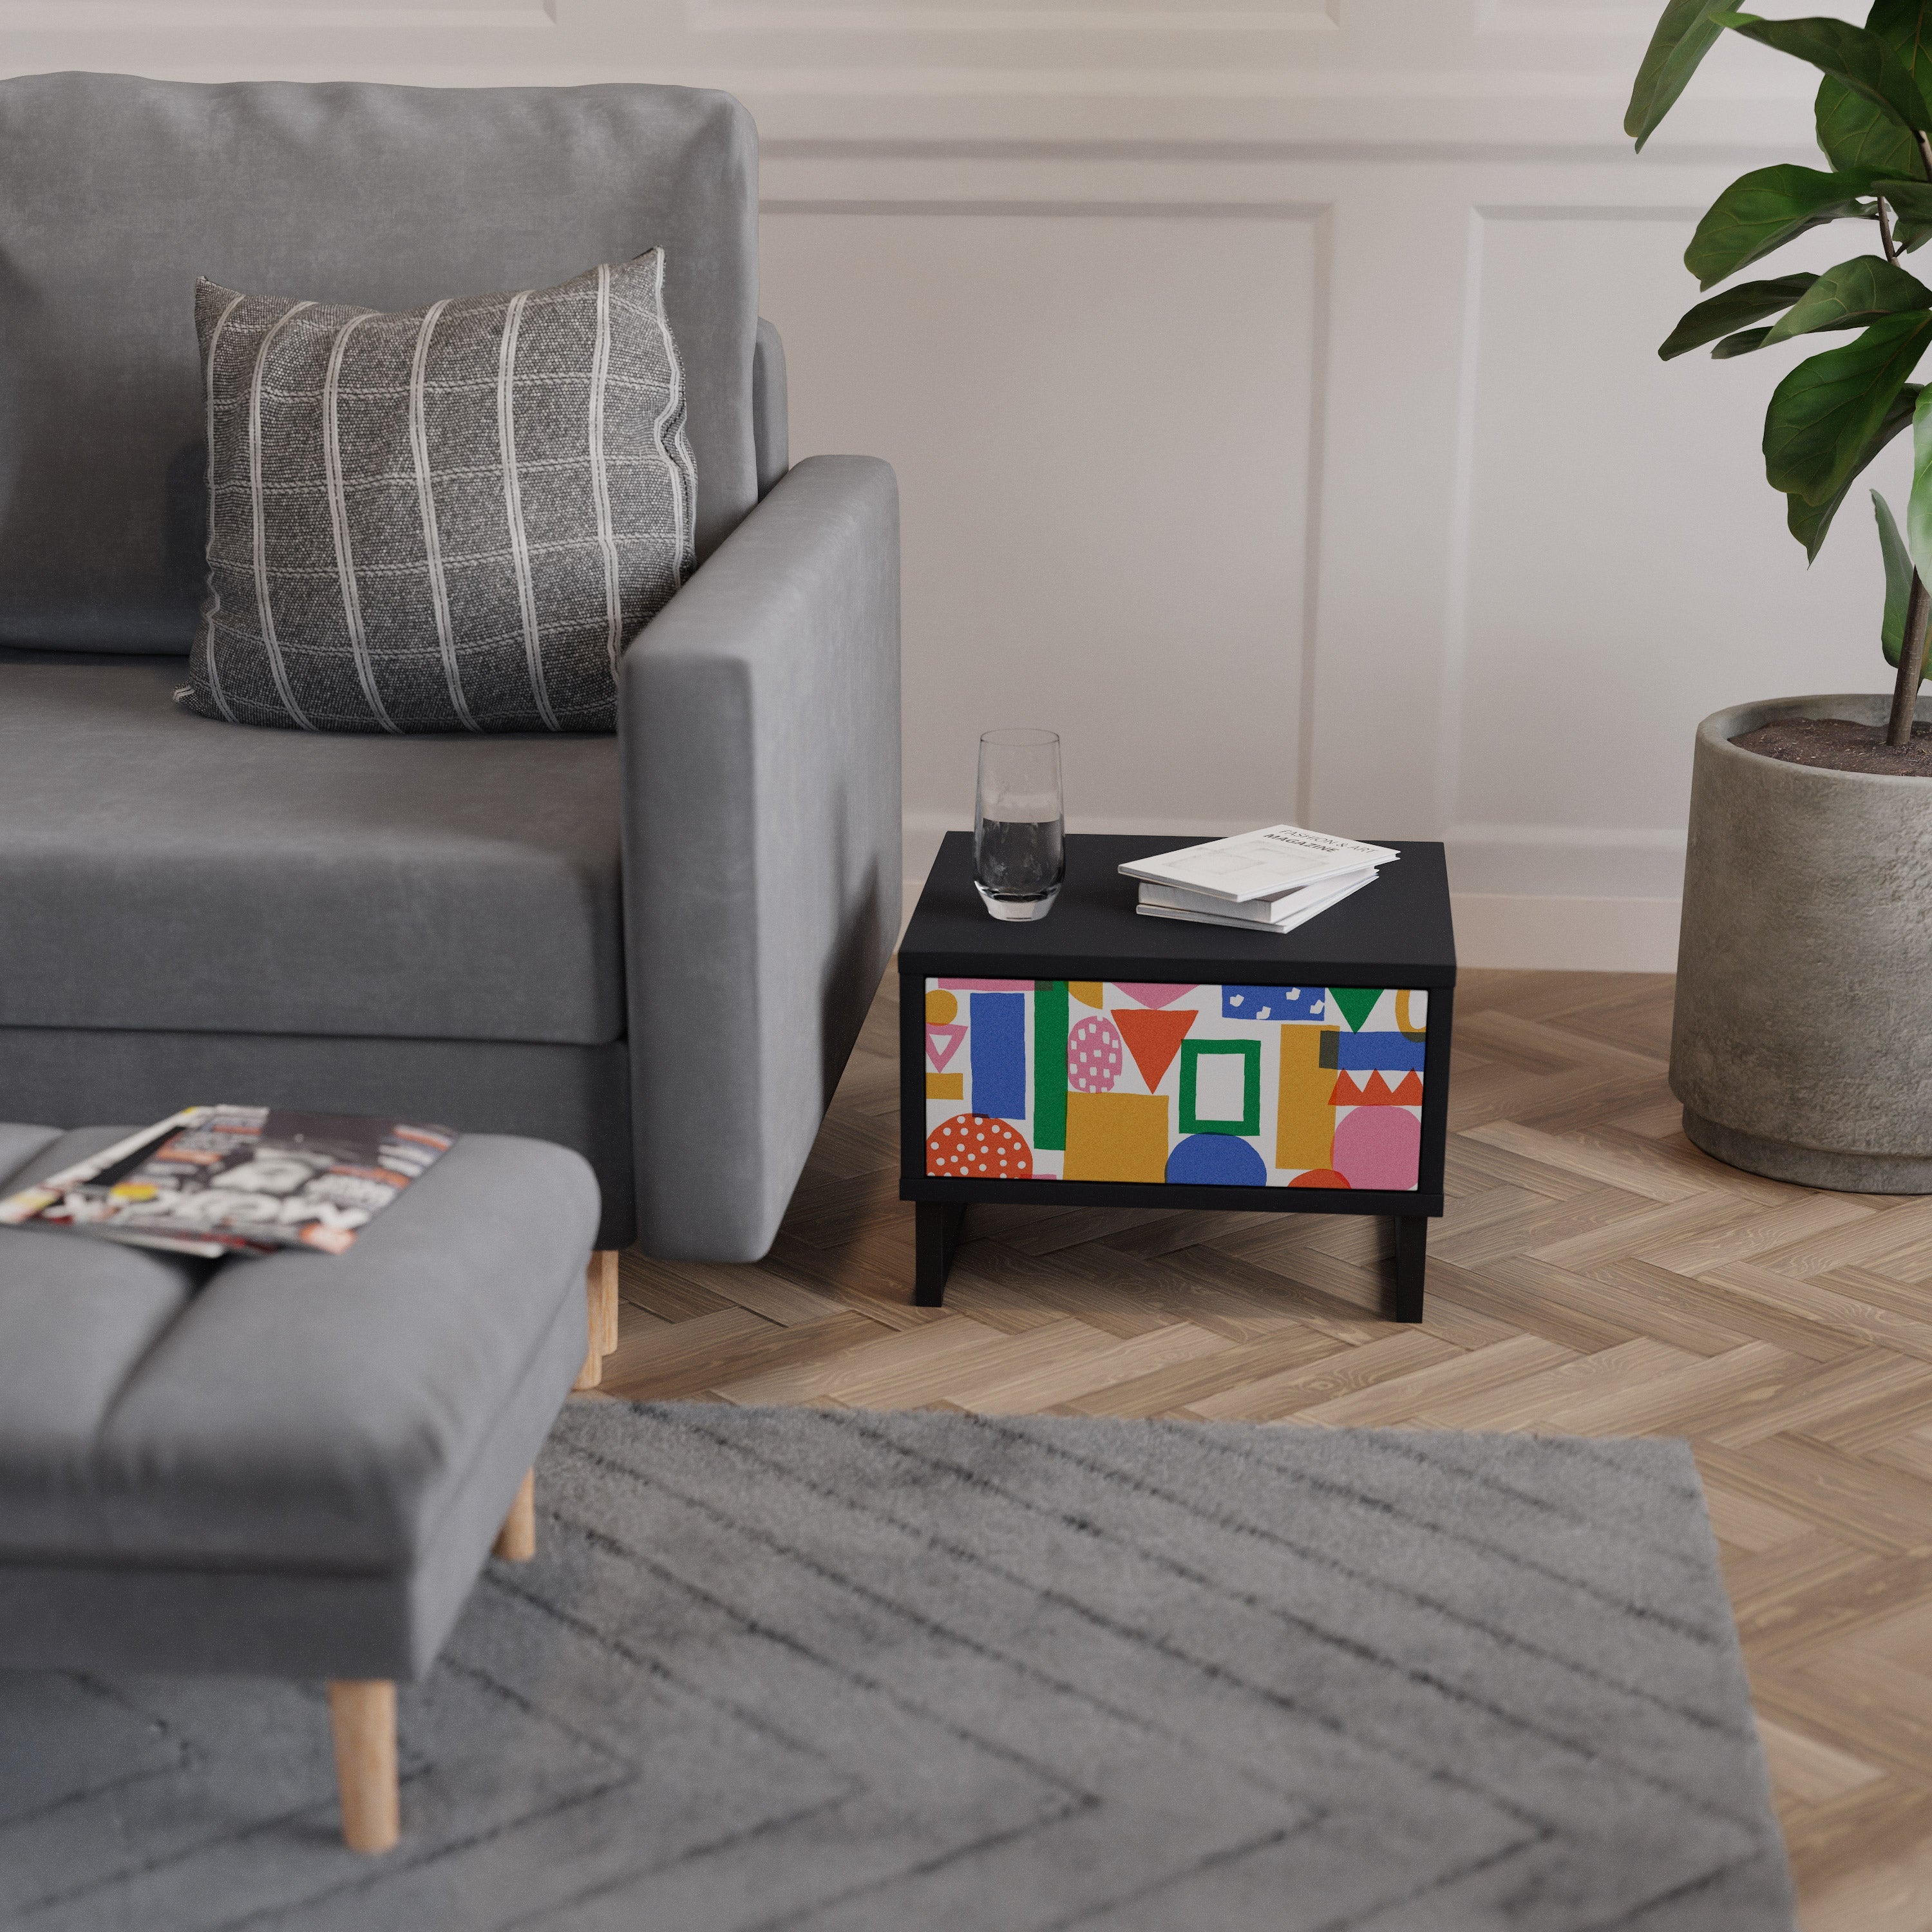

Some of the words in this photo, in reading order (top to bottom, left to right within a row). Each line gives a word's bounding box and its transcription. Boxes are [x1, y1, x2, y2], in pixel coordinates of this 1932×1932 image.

[1264, 833, 1340, 853] MAGAZINE
[1279, 829, 1337, 845] FASHION
[1347, 845, 1379, 853] ART
